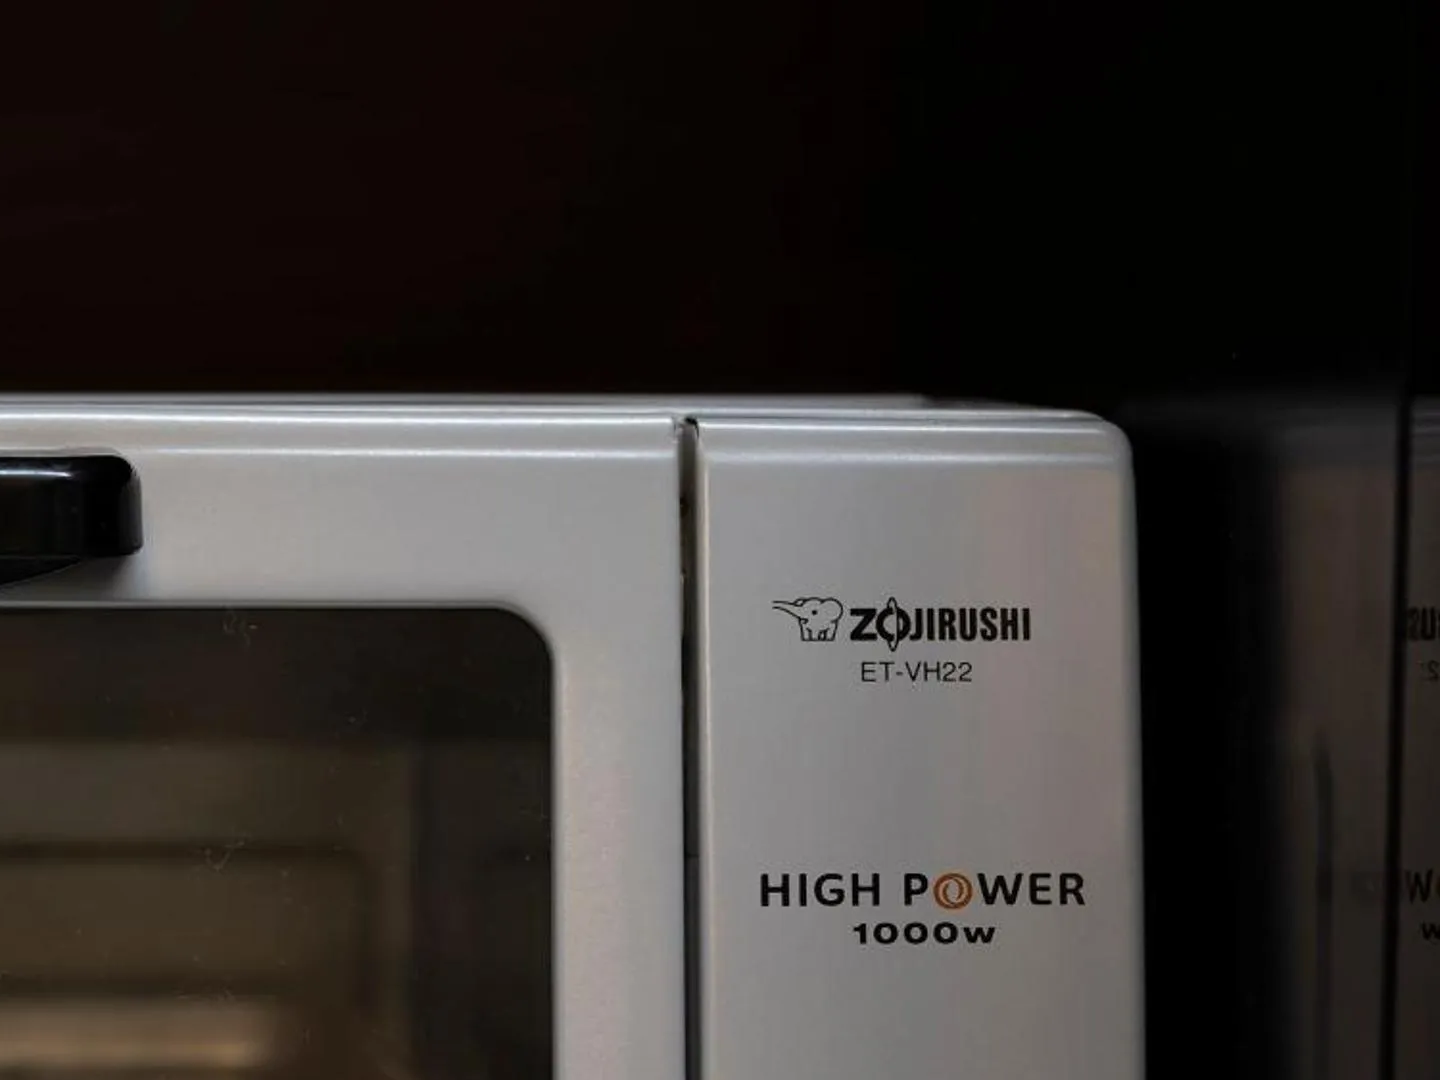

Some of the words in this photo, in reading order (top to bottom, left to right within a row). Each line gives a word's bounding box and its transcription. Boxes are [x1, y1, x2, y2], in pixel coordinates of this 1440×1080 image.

[850, 597, 1031, 652] ZOJIRUSHI
[861, 661, 973, 683] ET-VH22
[760, 872, 881, 907] HIGH
[904, 872, 1086, 910] POWER
